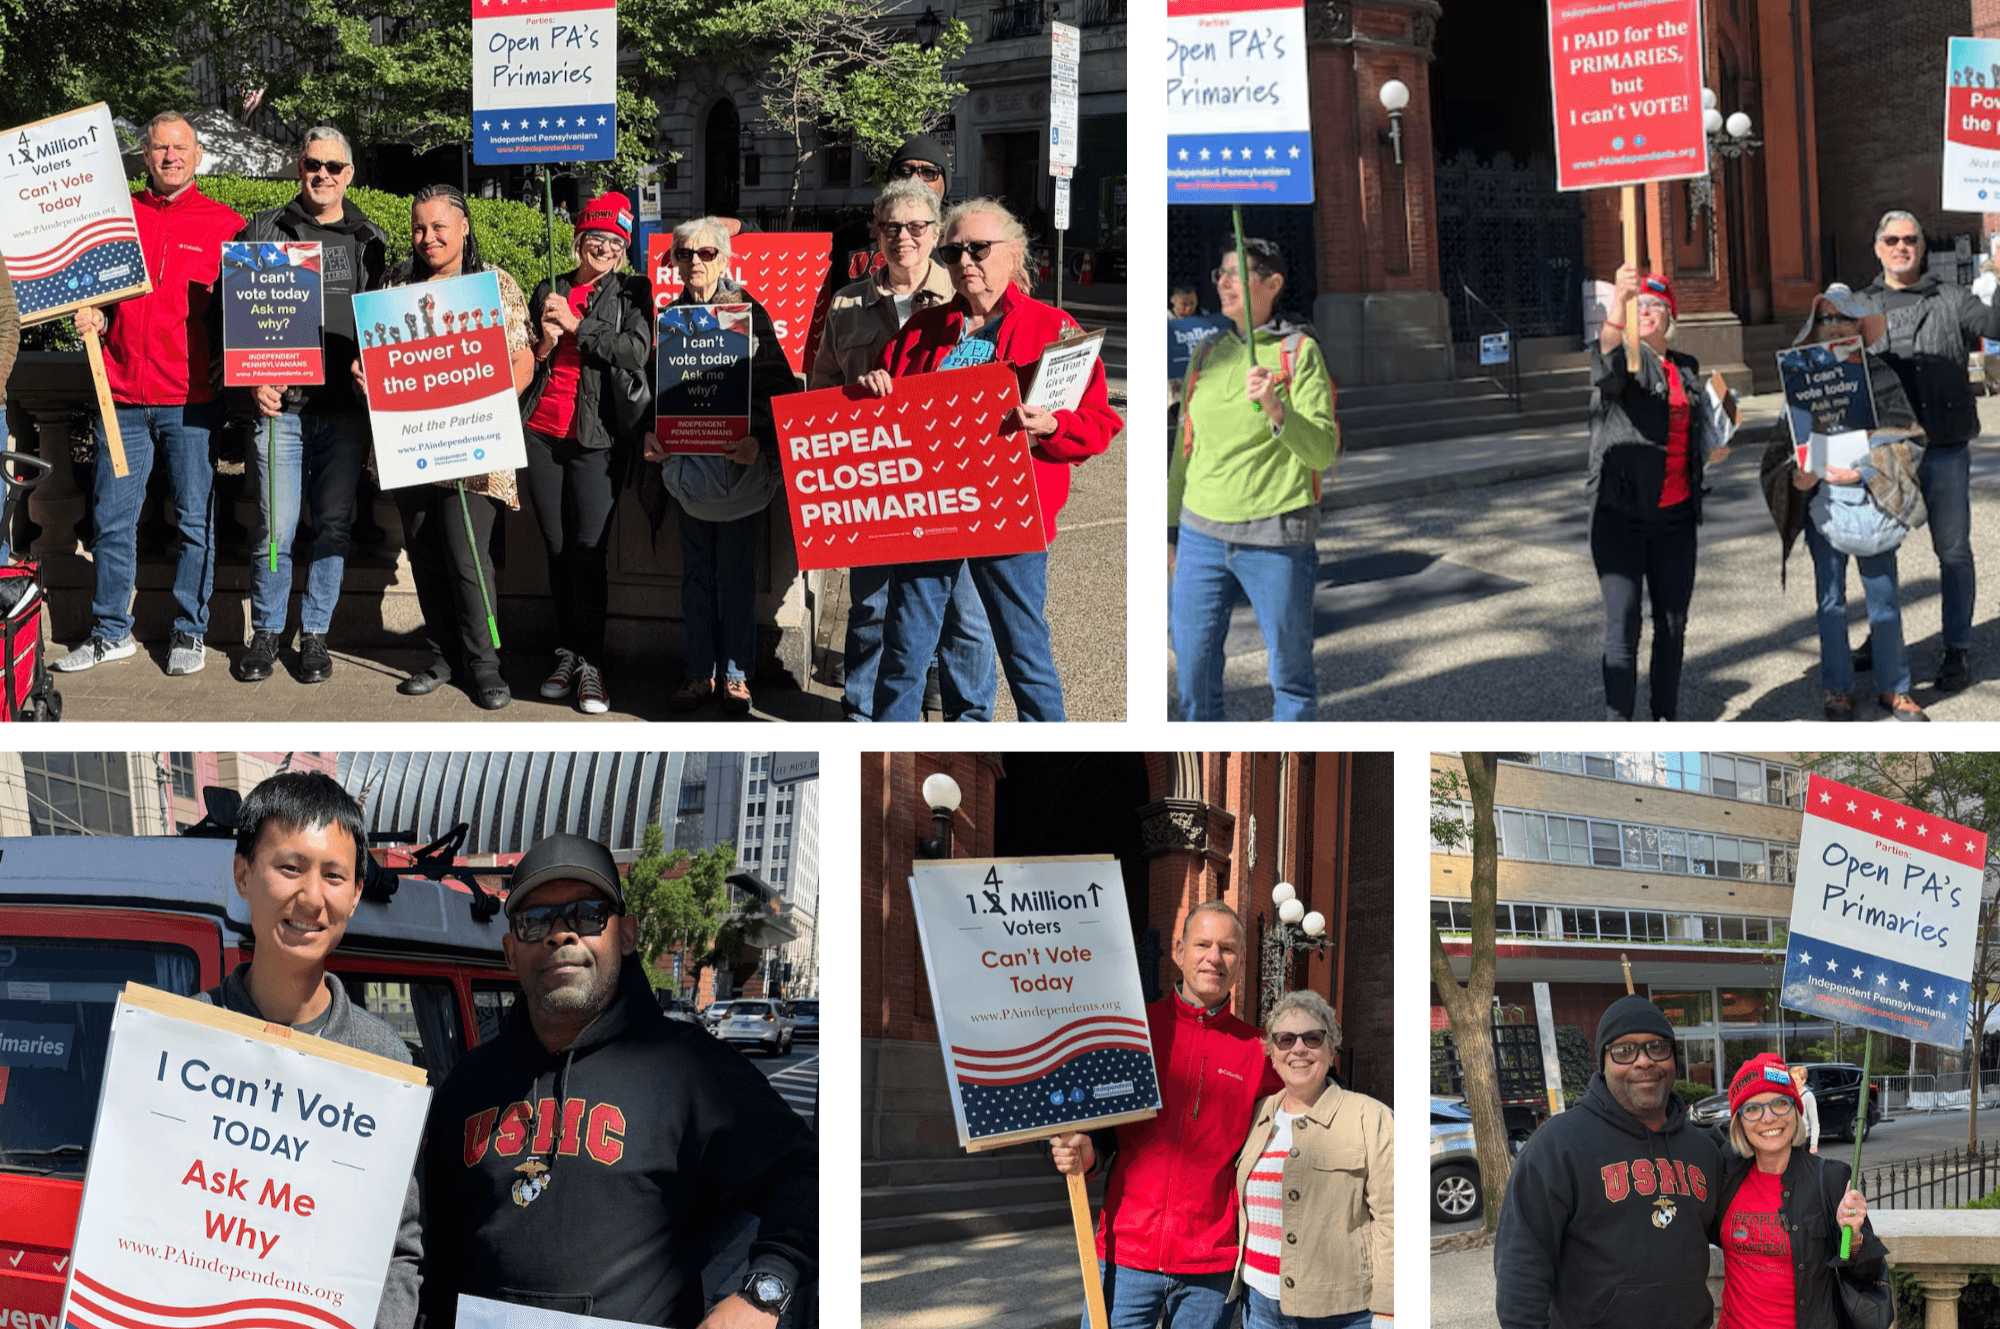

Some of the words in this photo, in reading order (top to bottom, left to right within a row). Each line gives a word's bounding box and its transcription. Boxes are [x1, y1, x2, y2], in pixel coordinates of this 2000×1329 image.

[489, 32, 539, 64] Open
[551, 24, 599, 49] PA's
[1229, 27, 1286, 59] PA's
[1563, 36, 1569, 52] I
[1574, 29, 1619, 50] PAID
[1624, 26, 1652, 43] for
[1657, 20, 1688, 38] the
[1570, 45, 1683, 75] PRIMARIES,
[493, 61, 592, 87] Primaries
[1610, 76, 1644, 95] but
[1167, 76, 1279, 106] Primaries
[1570, 109, 1576, 126] I
[1581, 104, 1625, 125] can't
[1630, 95, 1689, 118] VOTE!
[1962, 114, 1992, 131] the
[36, 134, 88, 160] Million
[490, 134, 537, 144] Independent
[538, 132, 598, 142] Pennsylvanians
[32, 158, 71, 176] Voters
[18, 180, 59, 201] Can't
[63, 172, 94, 191] Vote
[38, 195, 82, 215] Today
[251, 272, 255, 283] I
[260, 271, 296, 284] can't
[236, 289, 267, 300] vote
[271, 288, 310, 302] today
[251, 304, 274, 315] Ask
[278, 306, 296, 314] me
[258, 318, 290, 331] why?
[388, 343, 455, 368] Power
[461, 338, 482, 356] to
[682, 337, 687, 348] I
[691, 335, 725, 348] can't
[669, 354, 697, 365] vote
[701, 353, 738, 367] today
[383, 376, 417, 394] the
[423, 362, 495, 393] people
[681, 369, 703, 381] Ask
[707, 371, 724, 380] me
[1046, 378, 1065, 389] Give
[1066, 374, 1078, 385] up
[1805, 373, 1811, 384] I
[1813, 366, 1844, 382] can't
[687, 384, 718, 397] why?
[1049, 387, 1066, 399] Our
[1796, 387, 1823, 401] vote
[1824, 380, 1858, 396] today
[1810, 400, 1829, 412] Ask
[401, 422, 423, 436] Not
[426, 419, 446, 431] the
[449, 411, 493, 428] Parties
[397, 431, 501, 454] www.PAindependents.org
[789, 424, 912, 461] REPEAL
[795, 457, 923, 493] CLOSED
[801, 487, 981, 527] PRIMARIES
[789, 761, 807, 772] MUST
[1875, 840, 1912, 860] Parties:
[1822, 842, 1889, 888] Open
[1903, 863, 1962, 908] PA's
[1011, 890, 1088, 914] Million
[1003, 919, 1062, 937] Voters
[1822, 883, 1949, 948] Primaries
[981, 948, 1040, 969] Can't
[1045, 945, 1093, 966] Vote
[1009, 973, 1074, 994] Today
[1807, 974, 1871, 1000] Independent
[1873, 992, 1947, 1020] Pennsylvanians
[970, 999, 1121, 1024] www.PAindependents.org
[157, 1050, 169, 1083] I
[180, 1058, 284, 1114] Can't
[297, 1088, 377, 1139] Vote
[212, 1115, 310, 1164] TODAY
[463, 1097, 627, 1169] USMC
[181, 1159, 249, 1202] Ask
[258, 1178, 317, 1218] Me
[1601, 1158, 1707, 1203] USMC
[204, 1210, 281, 1261] Why
[118, 1236, 346, 1309] www.PAindependents.org
